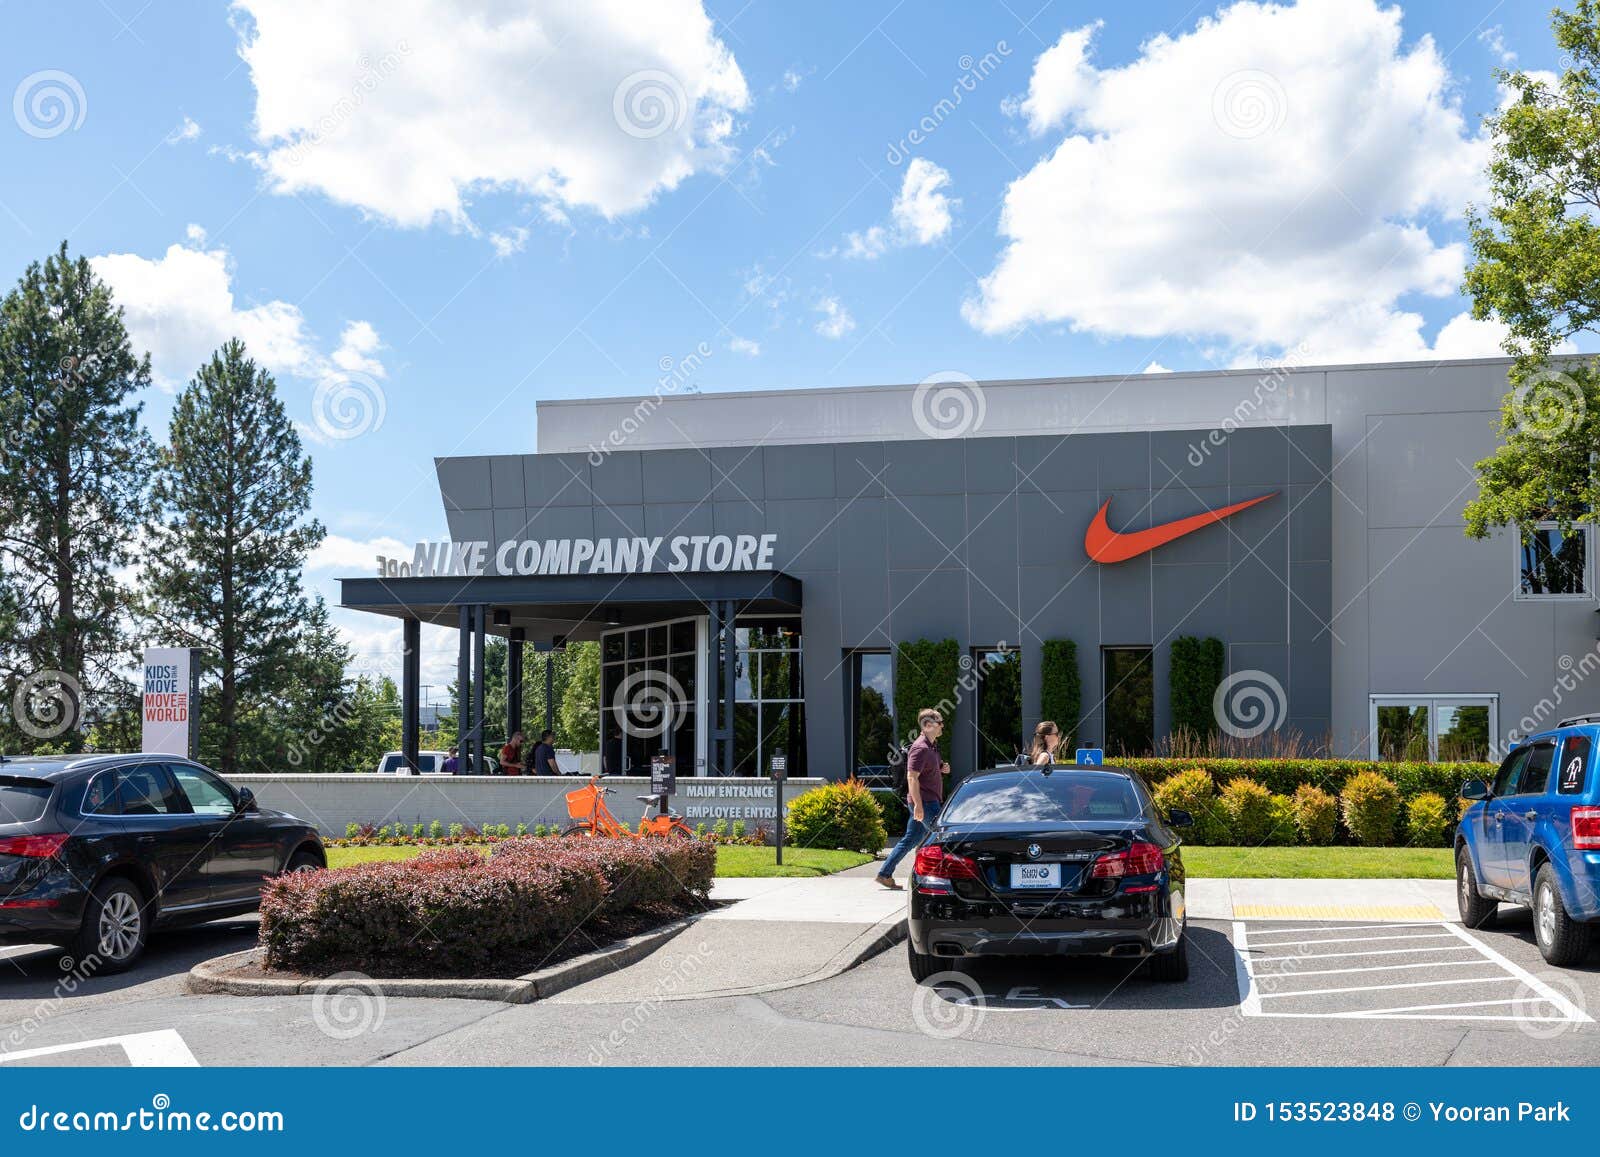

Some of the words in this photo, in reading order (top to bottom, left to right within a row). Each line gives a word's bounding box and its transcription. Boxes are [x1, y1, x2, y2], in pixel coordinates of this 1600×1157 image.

[411, 541, 488, 576] NIKE
[496, 537, 664, 575] COMPANY
[667, 534, 777, 572] STORE
[146, 665, 171, 679] KIDS
[146, 680, 177, 693] MOVE
[145, 693, 177, 707] MOVE
[145, 708, 187, 721] WORLD
[687, 785, 716, 797] MAIN
[719, 785, 774, 797] ENTRANCE
[686, 806, 741, 818] EMPLOYEE
